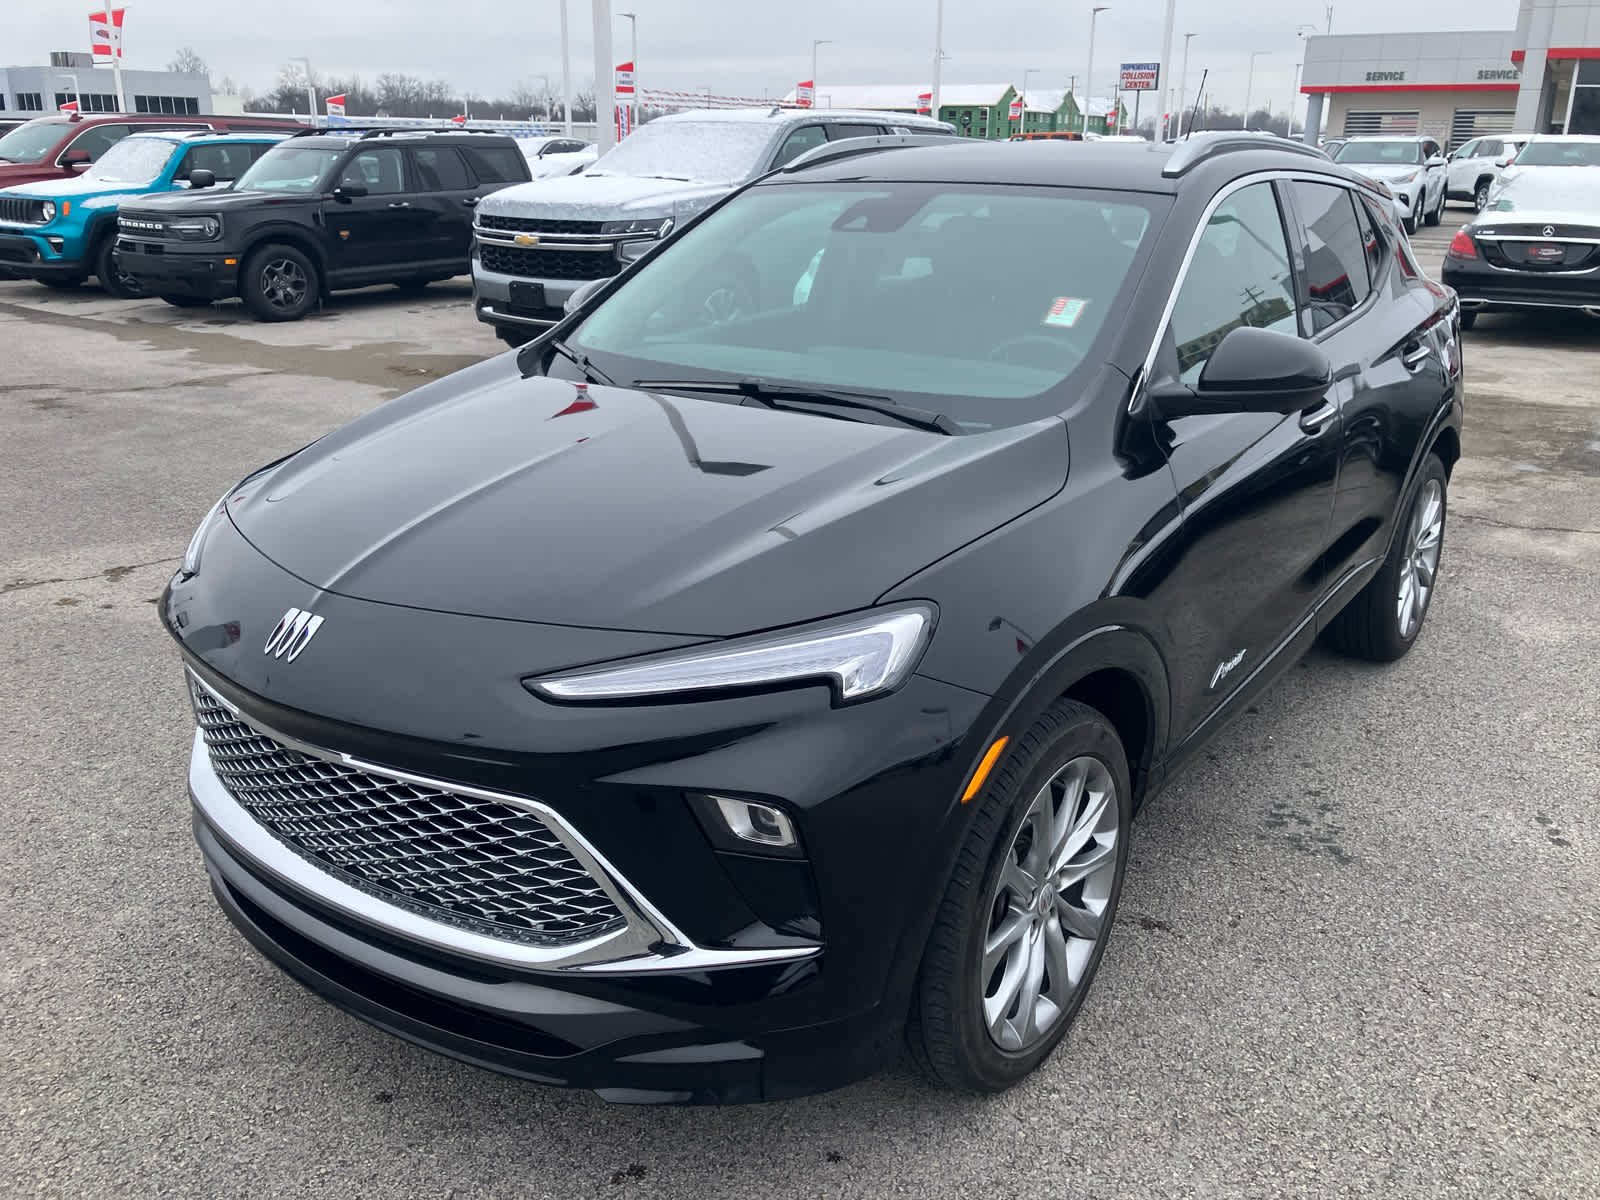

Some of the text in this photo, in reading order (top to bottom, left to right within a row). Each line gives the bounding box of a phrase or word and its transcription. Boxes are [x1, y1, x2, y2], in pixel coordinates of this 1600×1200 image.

[1365, 71, 1405, 82] SERVICE
[1477, 70, 1520, 80] SERVICE
[120, 220, 163, 230] BRONCO
